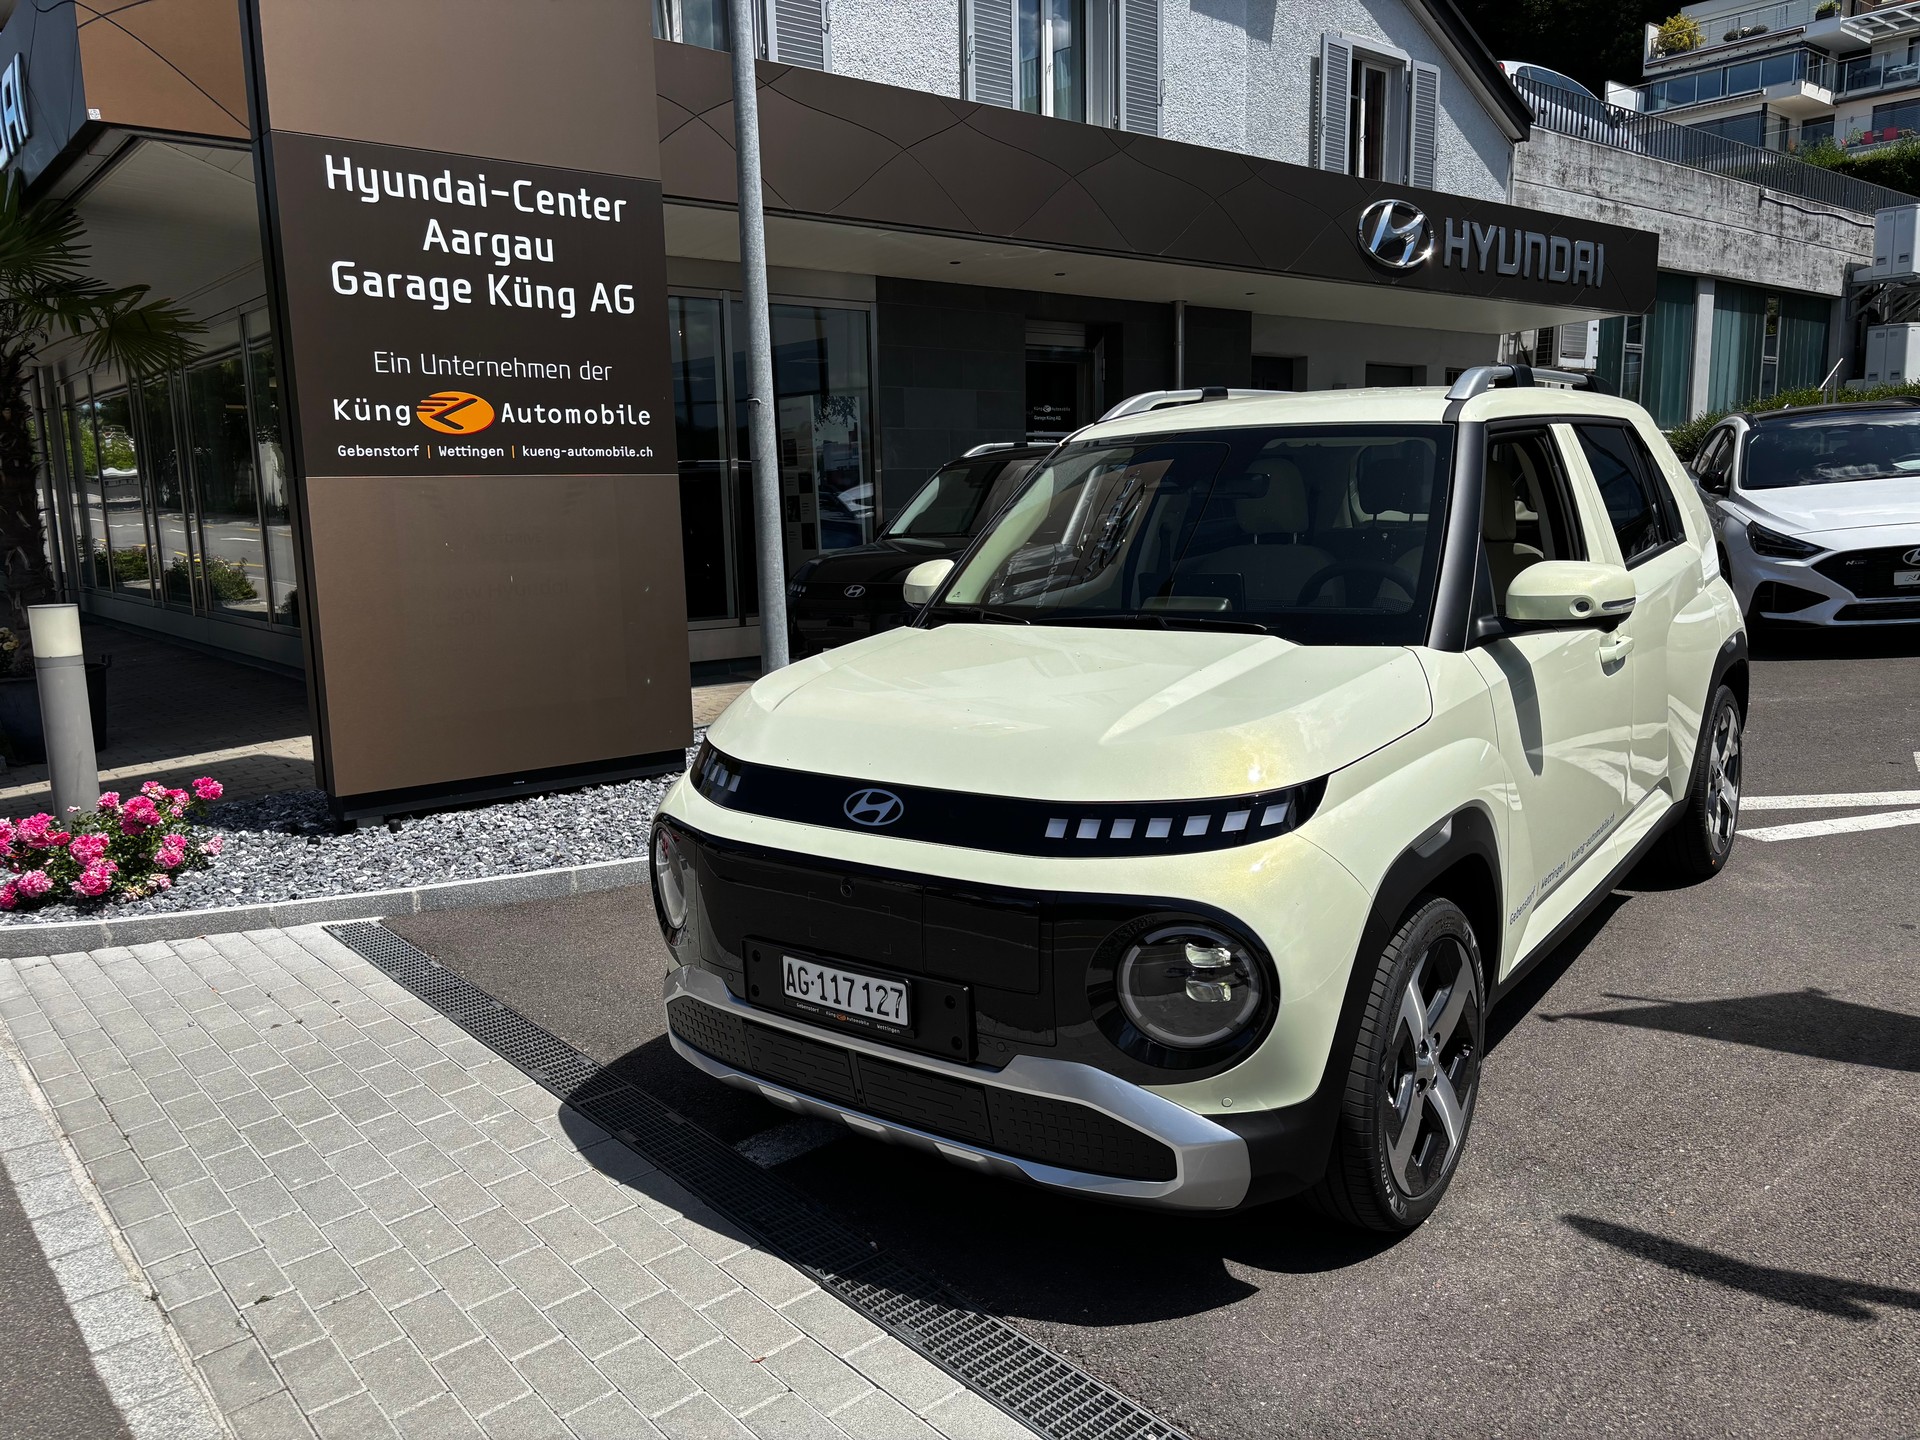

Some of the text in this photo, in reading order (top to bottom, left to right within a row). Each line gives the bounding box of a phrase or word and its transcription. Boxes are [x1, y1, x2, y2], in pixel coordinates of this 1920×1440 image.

[325, 154, 627, 222] Hyundai-Center
[422, 218, 554, 266] Aargau
[1443, 217, 1605, 287] HYUNDAI
[331, 261, 635, 319] Garage Küng AG
[373, 351, 613, 381] Ein Unternehmen der
[333, 398, 651, 426] Küng Automobile
[337, 445, 653, 459] Gebenstorf Wettingen kueng-automobile.ch
[796, 1002, 819, 1013] Gebenstorf
[876, 1023, 901, 1034] Wettingen
[861, 982, 904, 1019] 127
